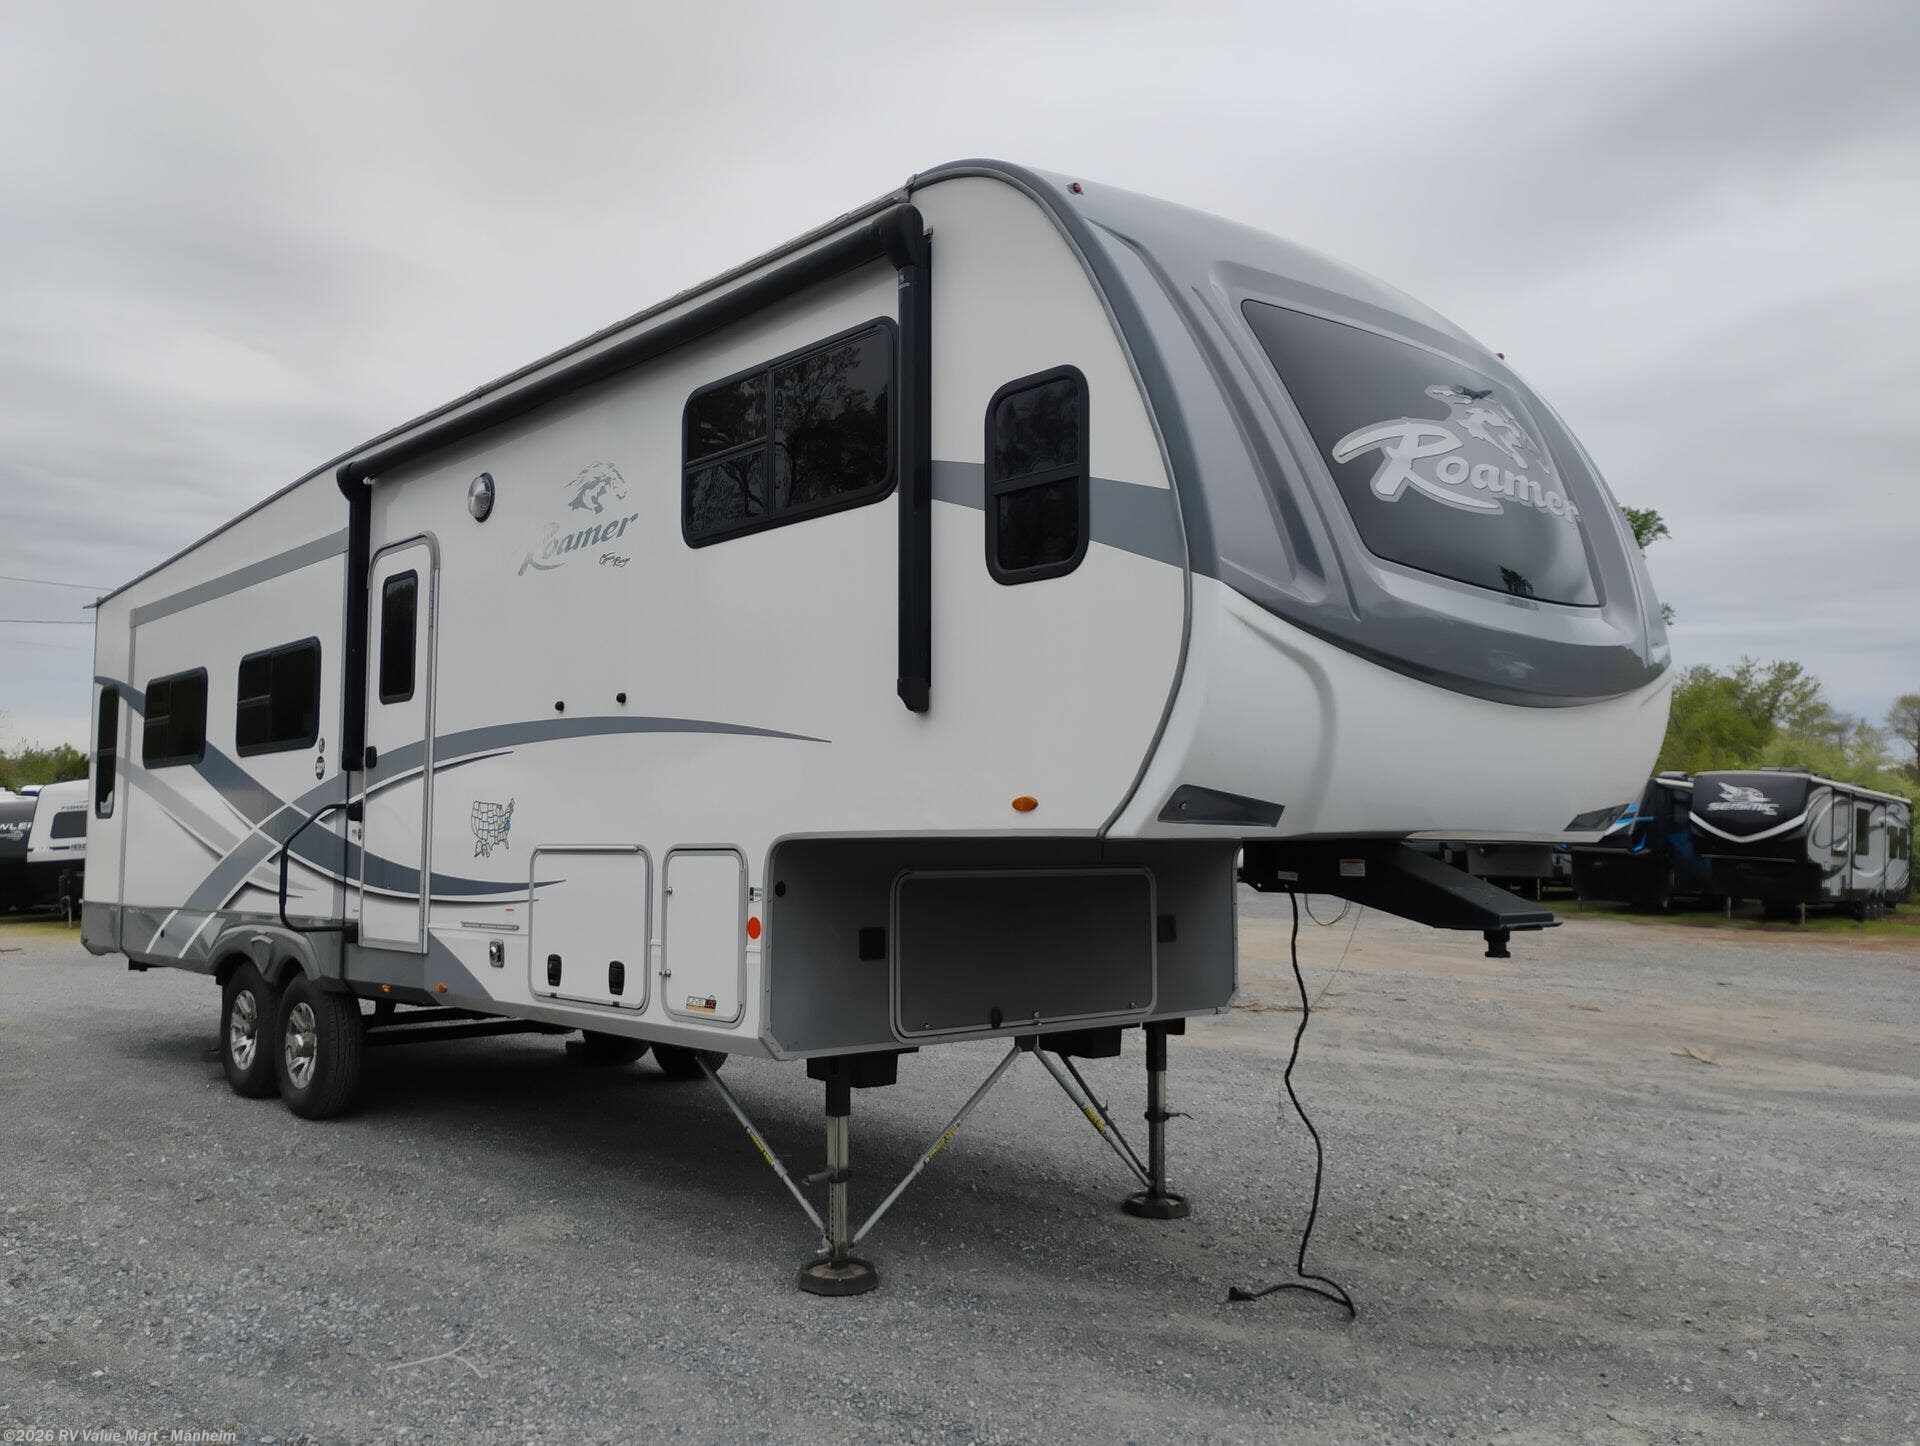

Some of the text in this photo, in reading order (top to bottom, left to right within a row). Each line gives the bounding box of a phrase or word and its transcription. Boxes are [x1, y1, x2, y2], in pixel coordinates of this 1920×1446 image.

[1333, 420, 1582, 522] Roamer
[518, 513, 639, 576] Roamer
[1707, 801, 1780, 811] SEISMIC
